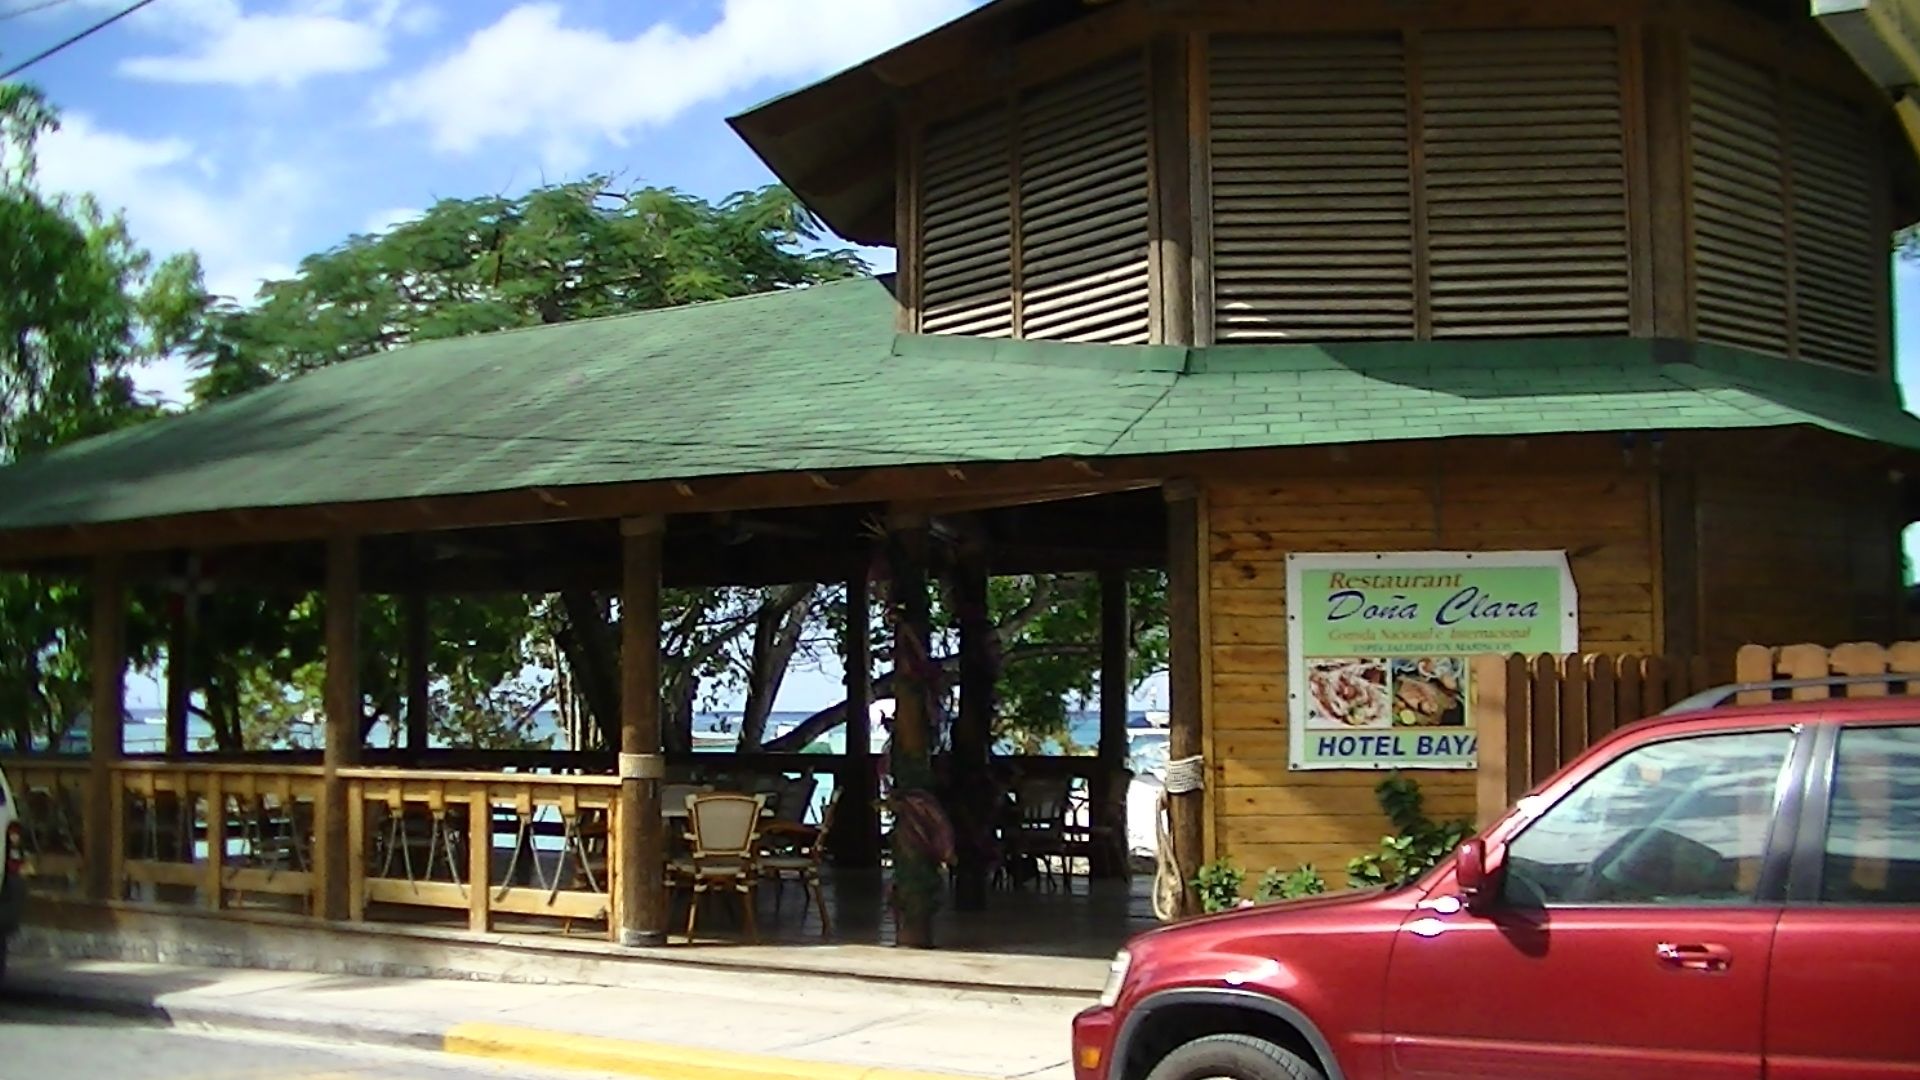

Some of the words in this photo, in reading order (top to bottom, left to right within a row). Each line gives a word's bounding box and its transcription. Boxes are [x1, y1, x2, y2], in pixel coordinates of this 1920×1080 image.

[1329, 571, 1463, 590] Restaurant
[1327, 590, 1419, 621] Doña
[1435, 586, 1539, 625] Clara
[1318, 735, 1406, 756] HOTEL
